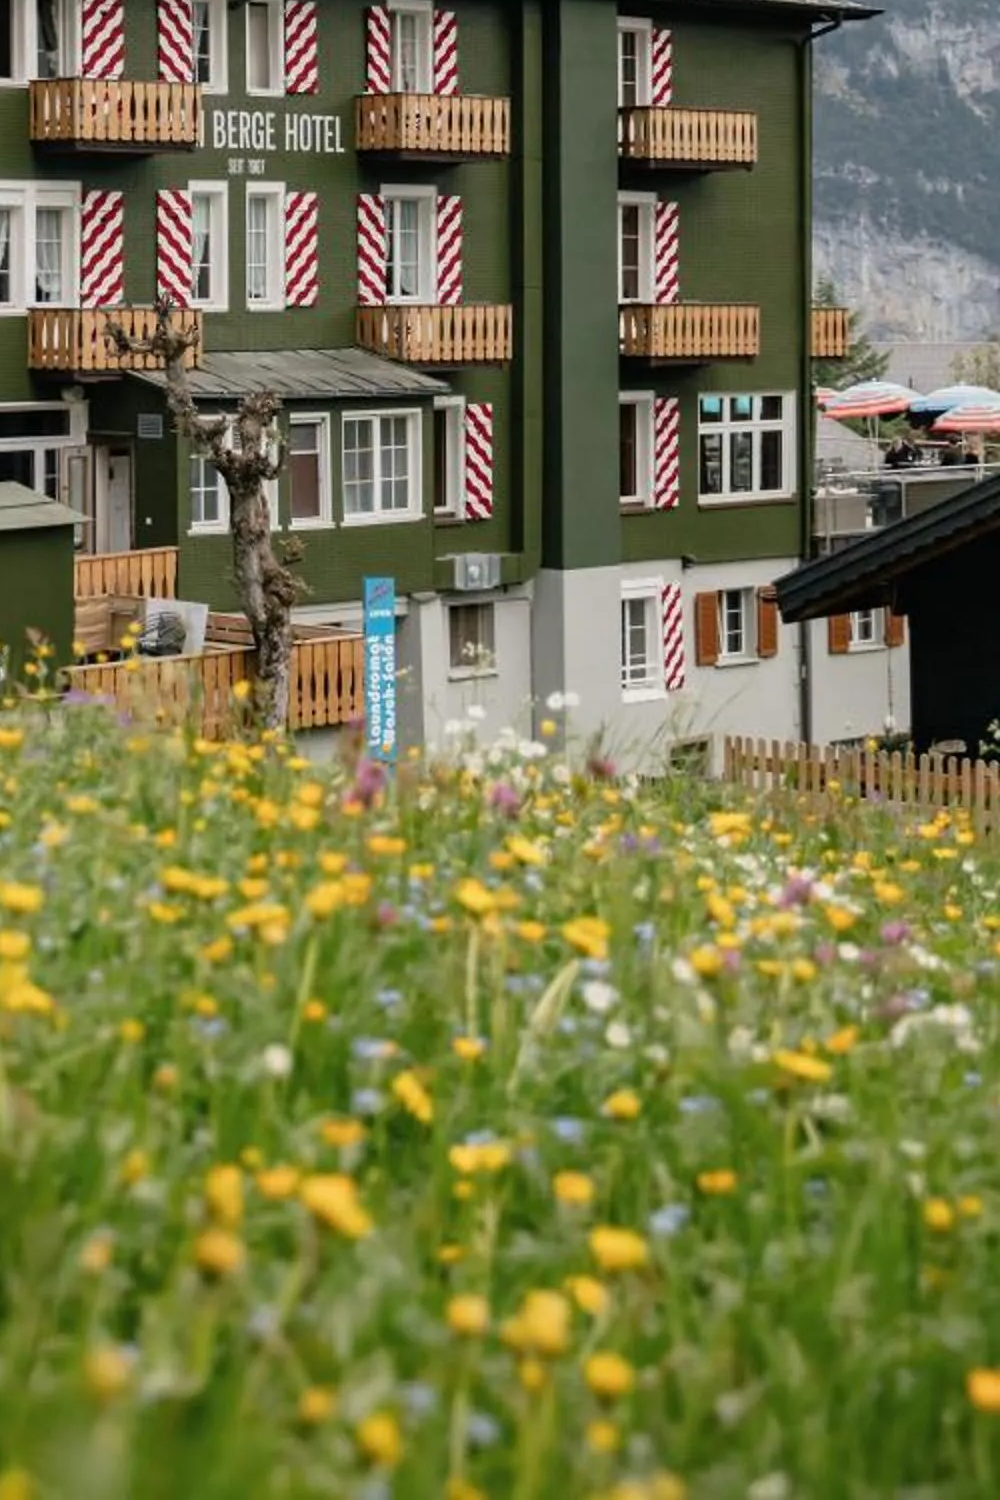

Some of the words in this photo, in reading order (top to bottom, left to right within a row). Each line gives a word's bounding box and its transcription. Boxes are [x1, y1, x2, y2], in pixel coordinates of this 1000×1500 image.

[213, 110, 276, 150] BERGE
[285, 113, 345, 153] HOTEL
[368, 635, 381, 746] Laundromat
